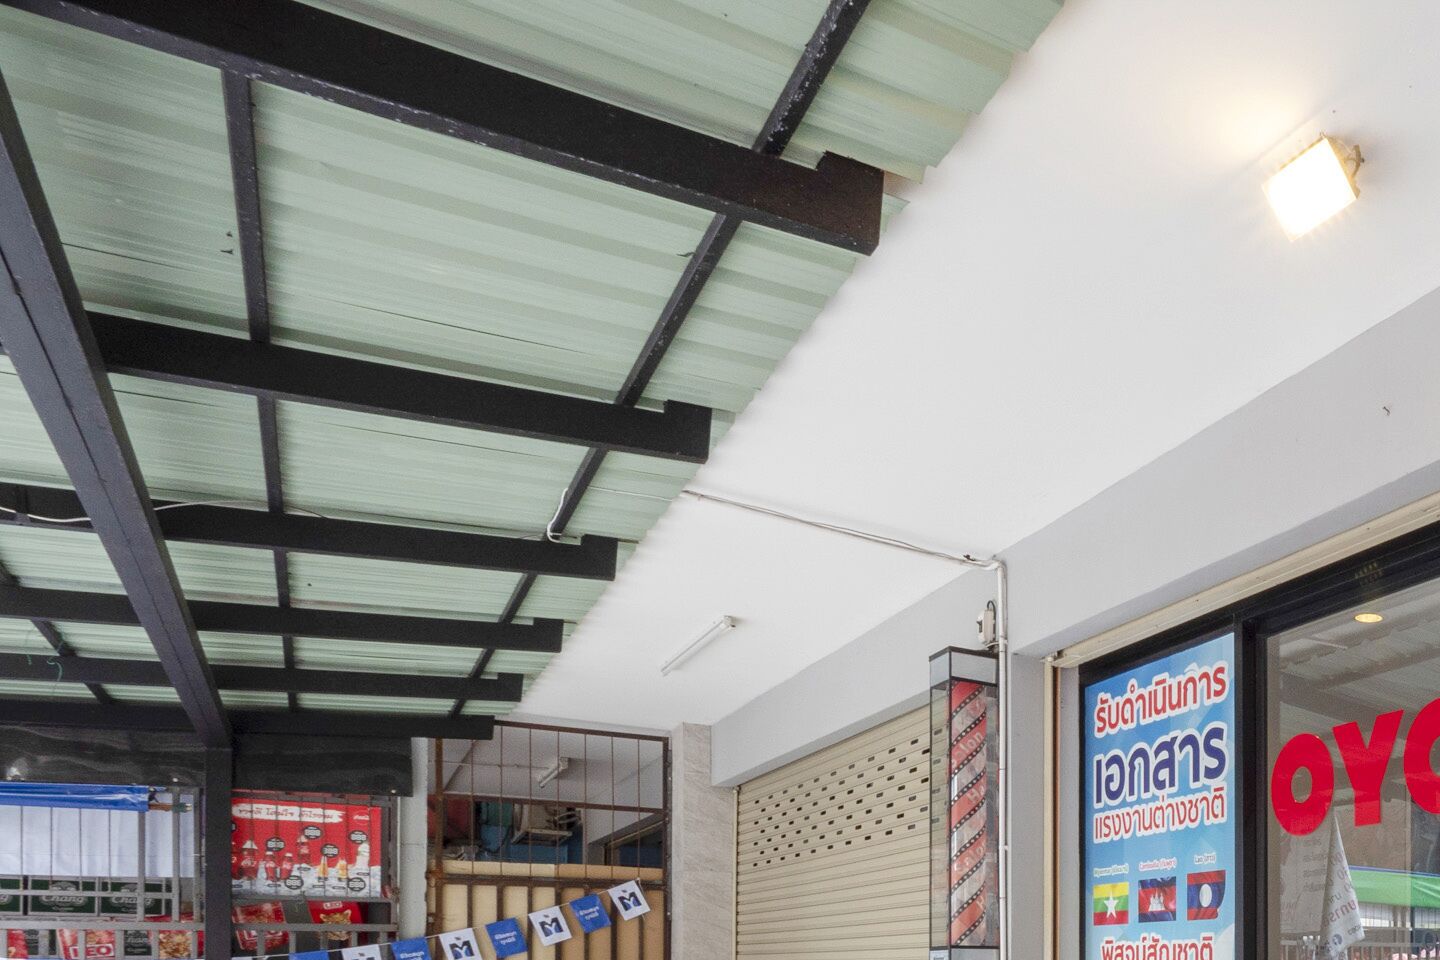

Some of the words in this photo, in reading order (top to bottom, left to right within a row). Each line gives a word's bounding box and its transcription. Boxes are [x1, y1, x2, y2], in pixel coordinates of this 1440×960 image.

[1096, 666, 1227, 733] รับดำเนินการ
[1095, 727, 1226, 804] เอกสาร
[1094, 786, 1225, 840] แรงงานต่างชาติ
